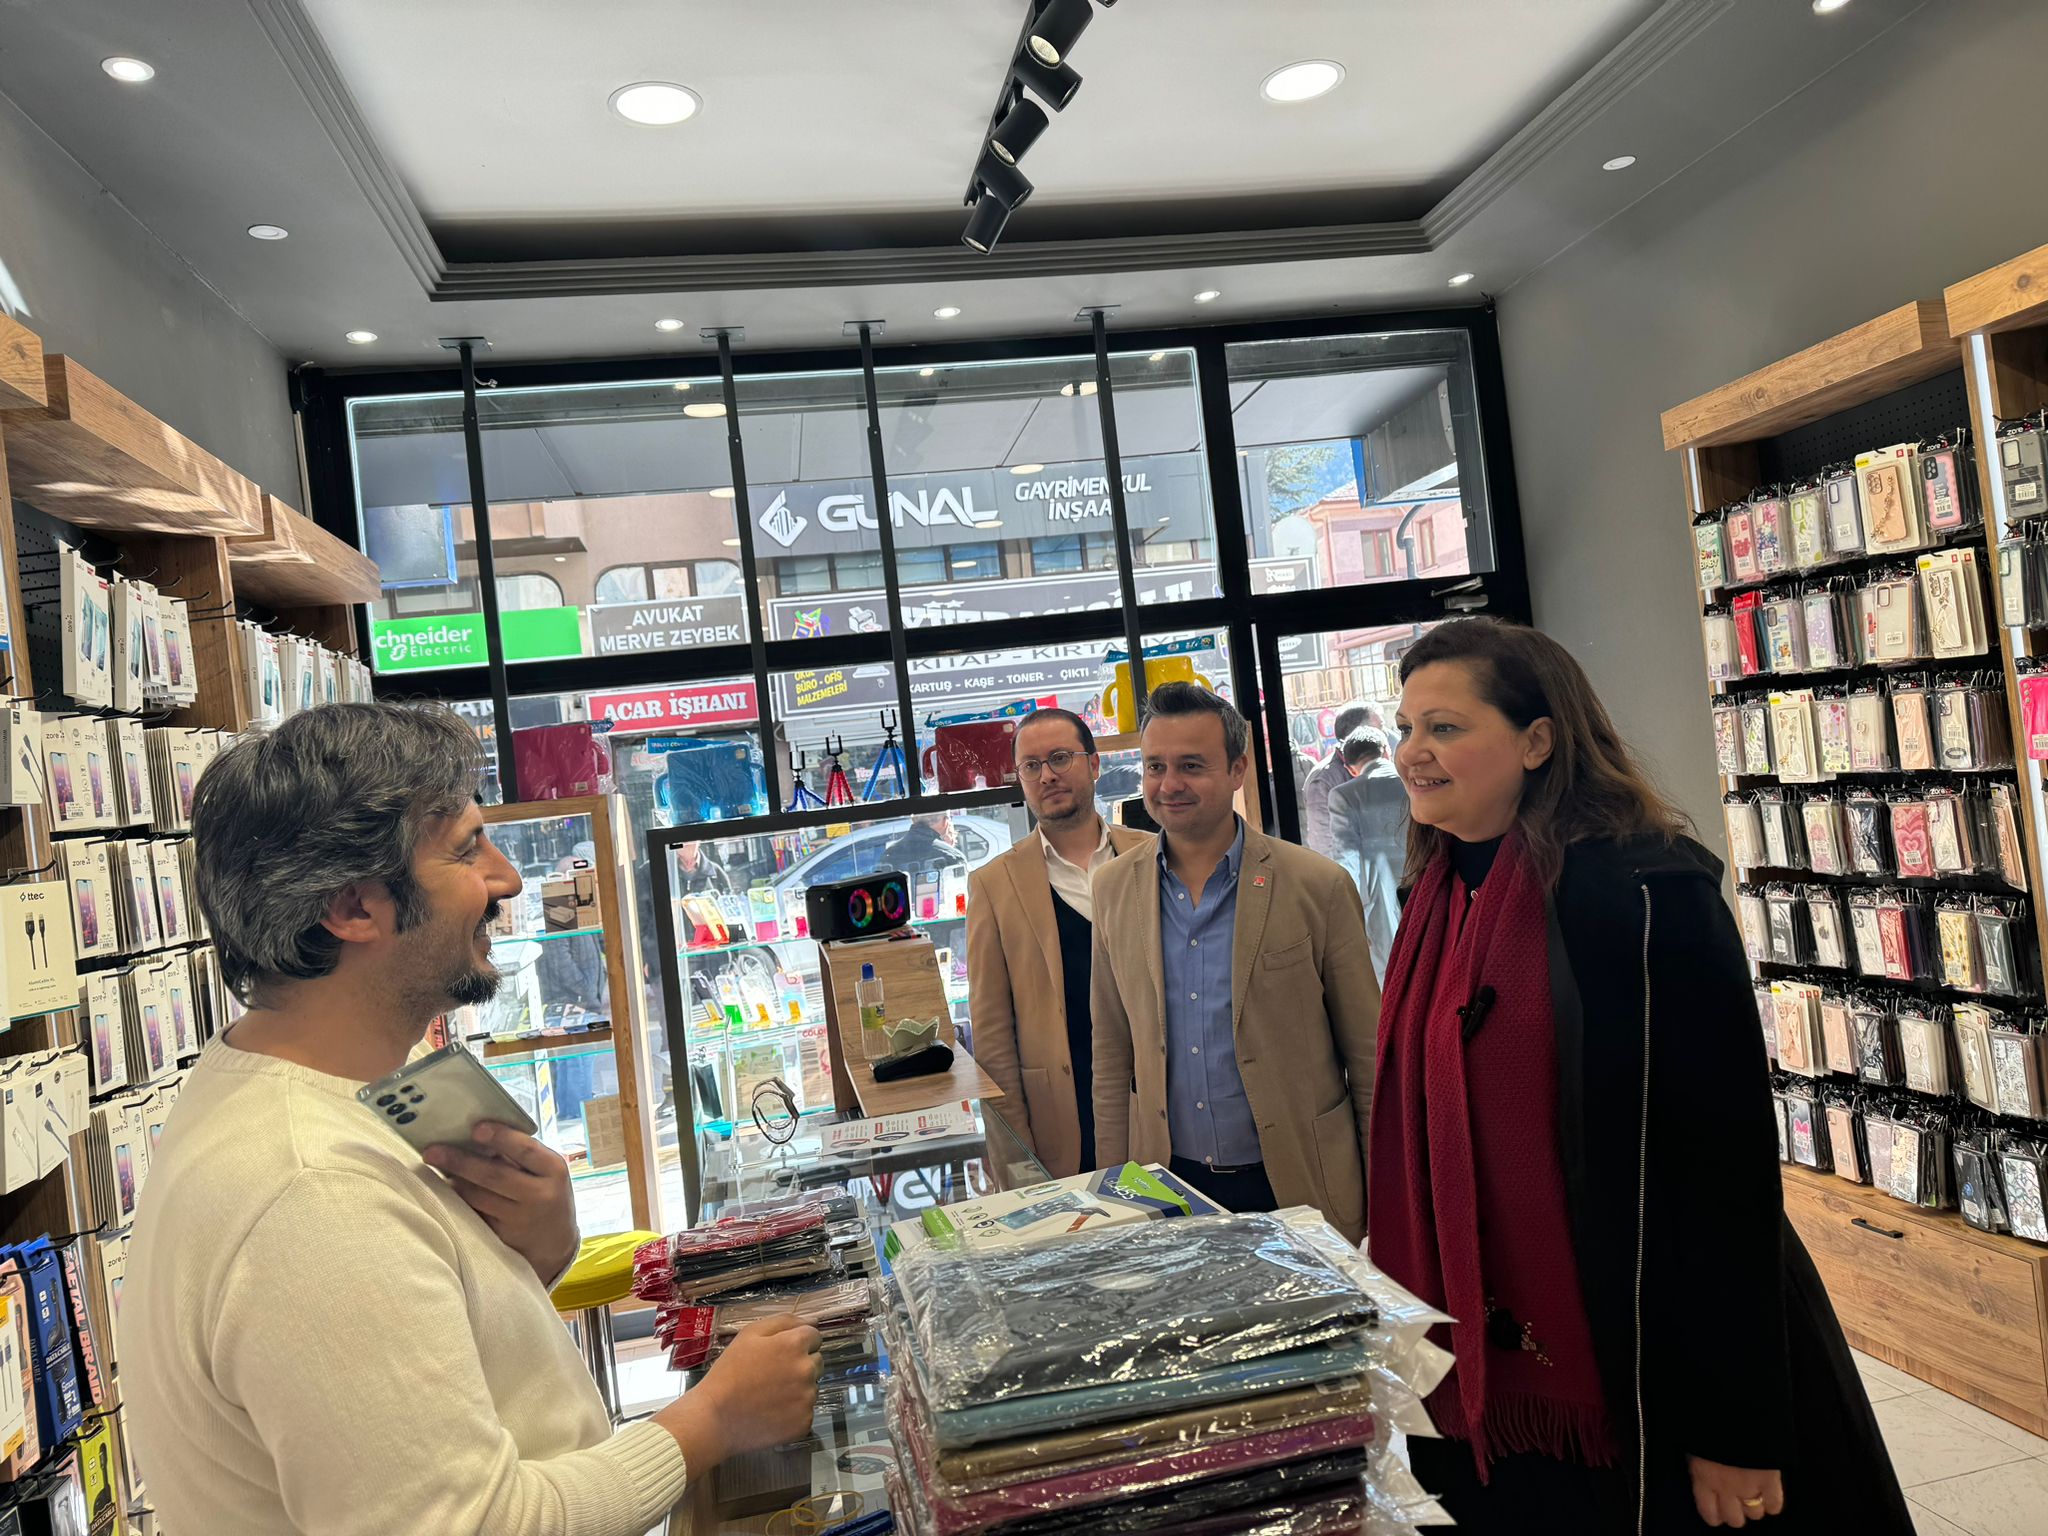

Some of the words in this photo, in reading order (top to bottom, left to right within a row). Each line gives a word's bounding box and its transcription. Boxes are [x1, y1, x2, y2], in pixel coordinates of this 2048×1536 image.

[2007, 426, 2024, 436] zore
[1926, 444, 1941, 452] zore
[1049, 498, 1112, 522] İNŞAA
[632, 605, 704, 626] AVUKAT
[376, 626, 472, 648] chneider
[600, 631, 666, 652] MERVE
[669, 624, 740, 646] ZEYBEK
[410, 644, 472, 657] Electric
[824, 670, 842, 684] OFİS
[964, 676, 994, 688] KAŞE
[1006, 672, 1044, 684] TONER
[1060, 667, 1088, 680] ÇIKTI
[797, 680, 848, 706] MALZEMELERİ
[604, 700, 663, 722] ACAR
[668, 692, 747, 720] İŞHANI
[28, 892, 44, 900] ttec
[1998, 1024, 2013, 1032] zore
[146, 1104, 160, 1114] zore
[108, 1257, 122, 1268] zore
[79, 1330, 102, 1405] BRAID
[92, 1516, 103, 1530] DATA
[101, 1507, 116, 1520] CABLE
